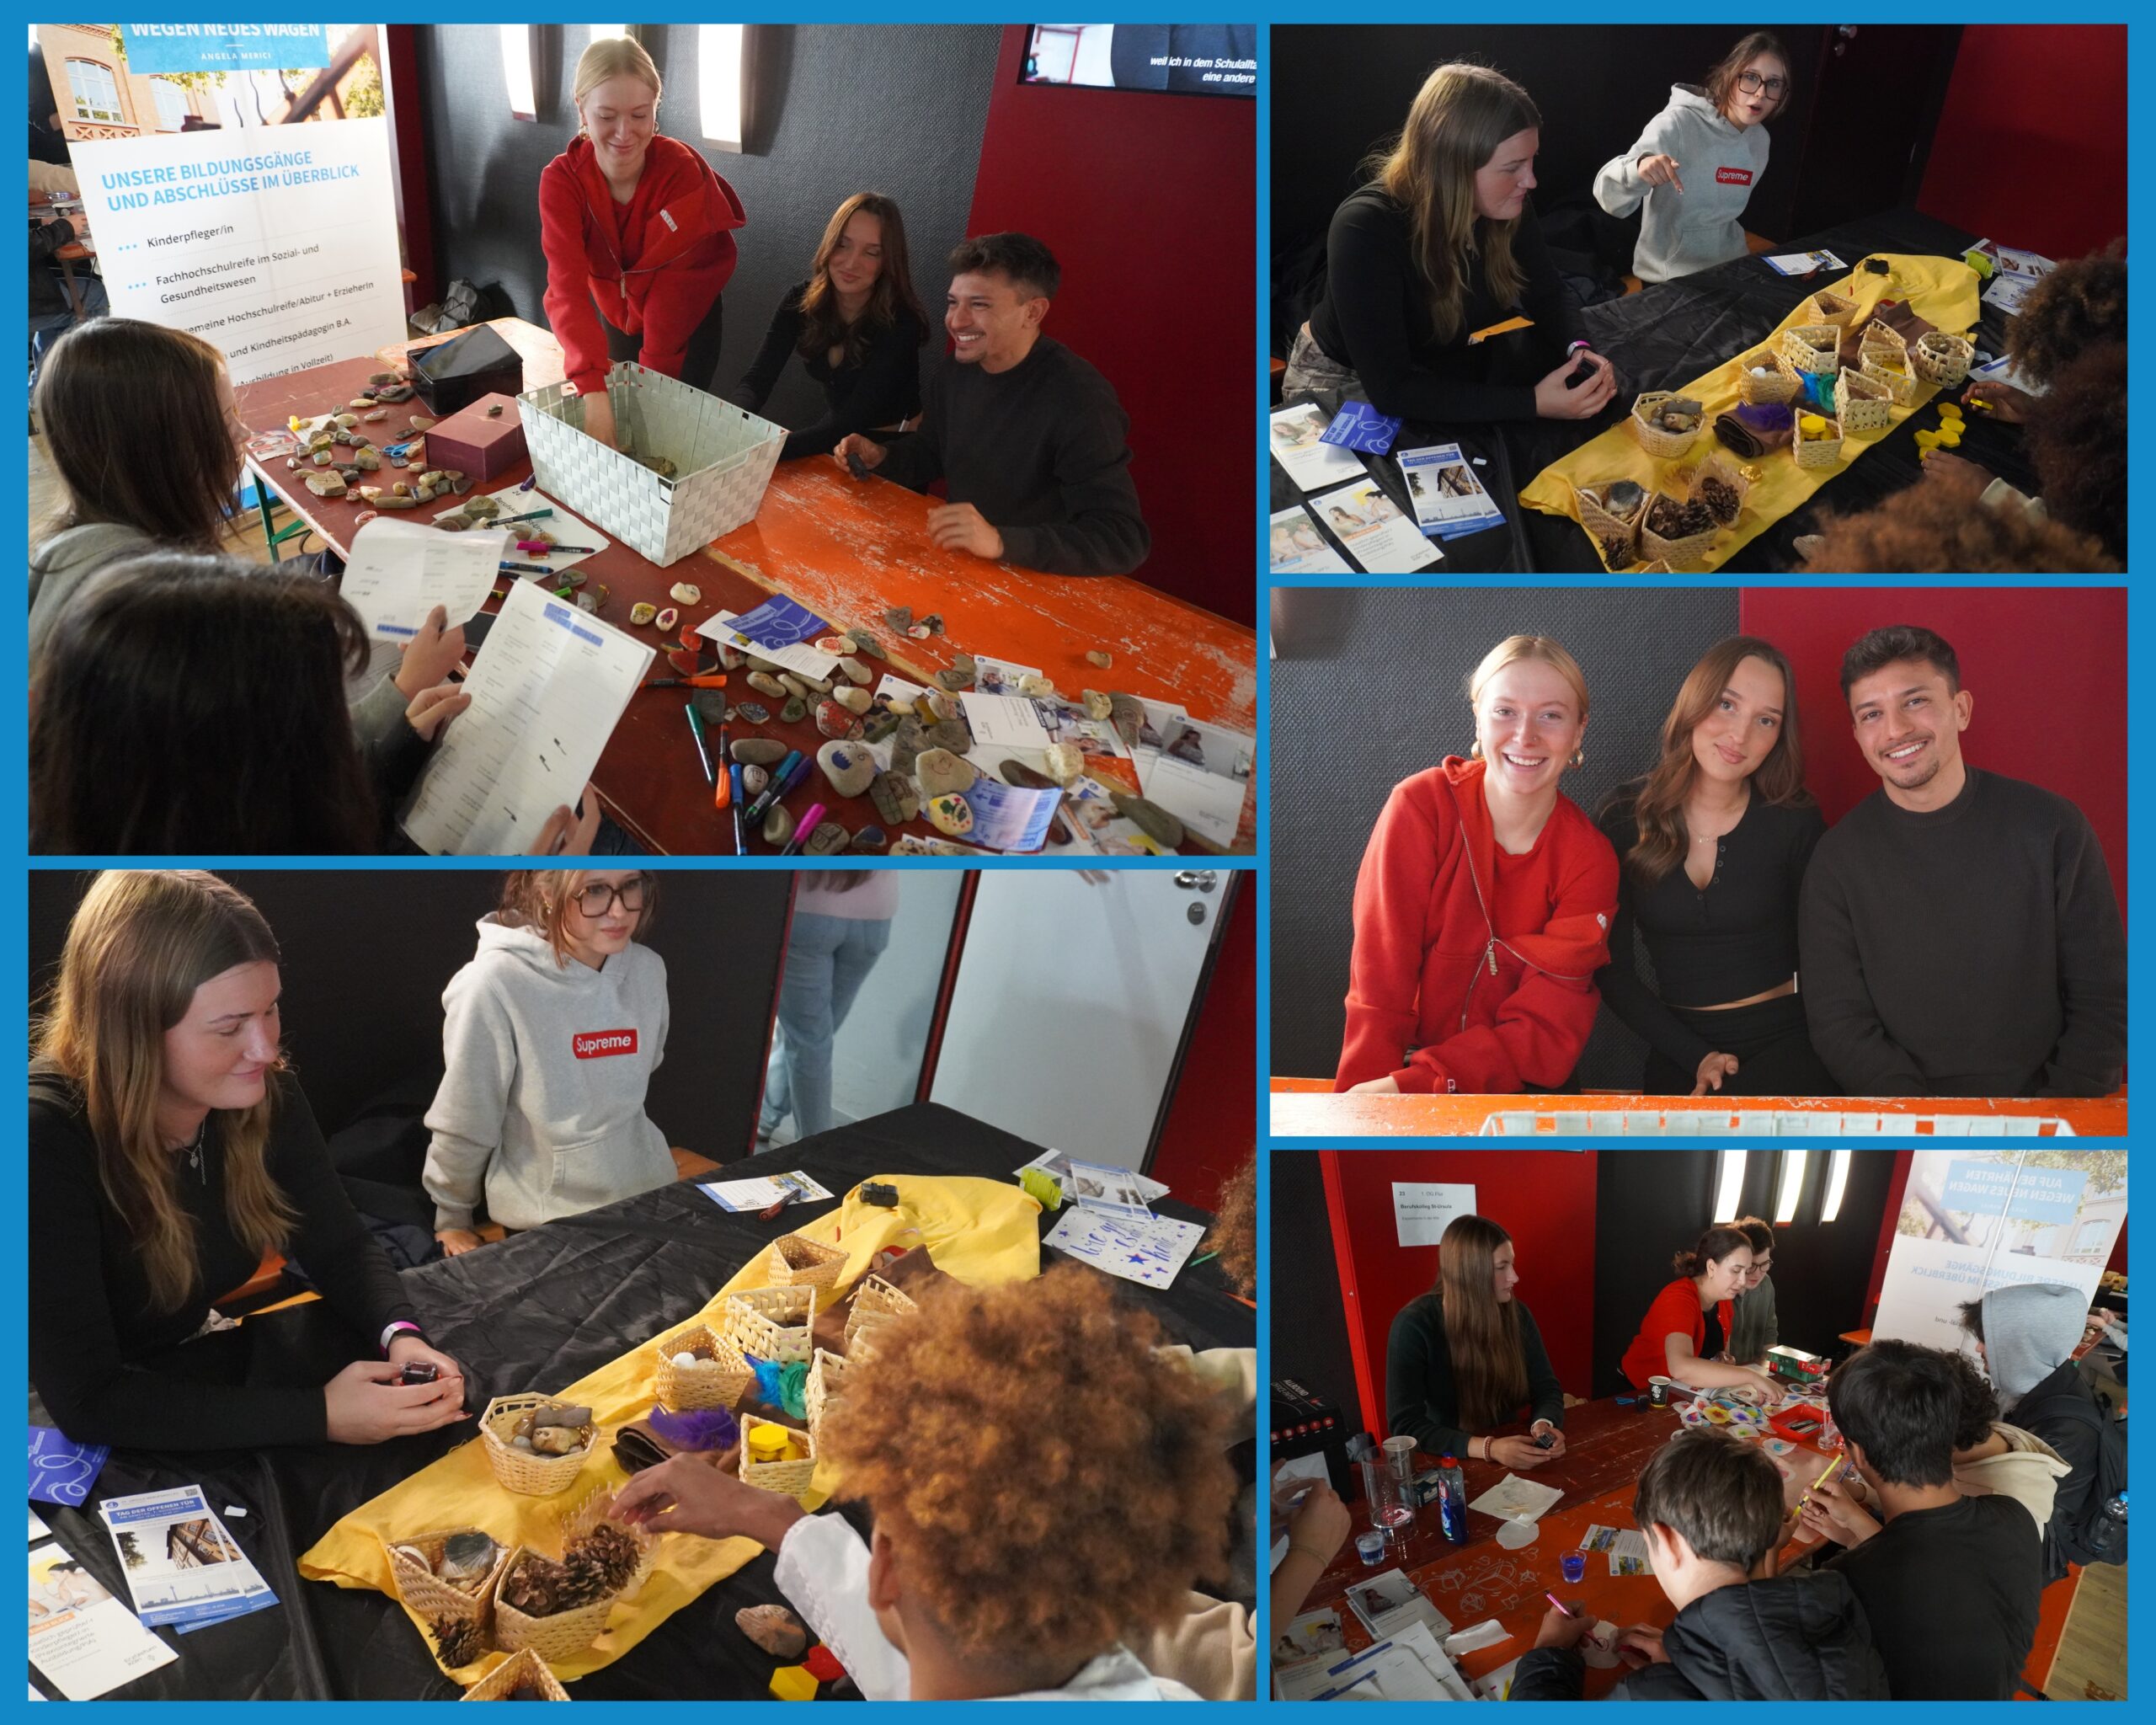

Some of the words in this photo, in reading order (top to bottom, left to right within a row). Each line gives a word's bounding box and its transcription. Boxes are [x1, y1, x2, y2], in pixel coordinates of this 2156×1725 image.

[131, 24, 200, 36] WEGEN
[204, 24, 260, 36] NEUES
[263, 24, 319, 36] WAGEN
[241, 51, 271, 60] MERICI
[1150, 56, 1167, 66] weil
[1168, 56, 1182, 67] ich
[1183, 57, 1192, 67] in
[1193, 58, 1213, 68] dem
[1214, 58, 1257, 68] Schulallta
[1203, 72, 1222, 83] eine
[1224, 73, 1256, 83] andere
[102, 166, 177, 190] UNSERE
[180, 151, 312, 179] BILDUNGSGÄNGE
[1718, 169, 1748, 181] Supreme
[107, 192, 149, 211] UND
[153, 177, 259, 206] ABSCHLÜSSE
[262, 174, 280, 190] IM
[282, 164, 360, 186] ÜBERBLICK
[147, 223, 235, 248] Kinderpfleger/in
[156, 257, 255, 286] Fachhochschulreife
[257, 254, 270, 264] im
[272, 248, 301, 262] Sozial-
[302, 243, 319, 256] und
[160, 275, 256, 304] Gesundheitswesen
[227, 292, 325, 325] Hochschulreife/Abitur
[229, 346, 249, 359] und
[250, 323, 335, 353] Kindheitspädagogin
[336, 318, 352, 328] B.A.
[291, 363, 299, 373] in
[301, 354, 334, 369] Vollzeit)
[577, 1036, 631, 1055] Supreme
[147, 1502, 179, 1512] OFFENEN
